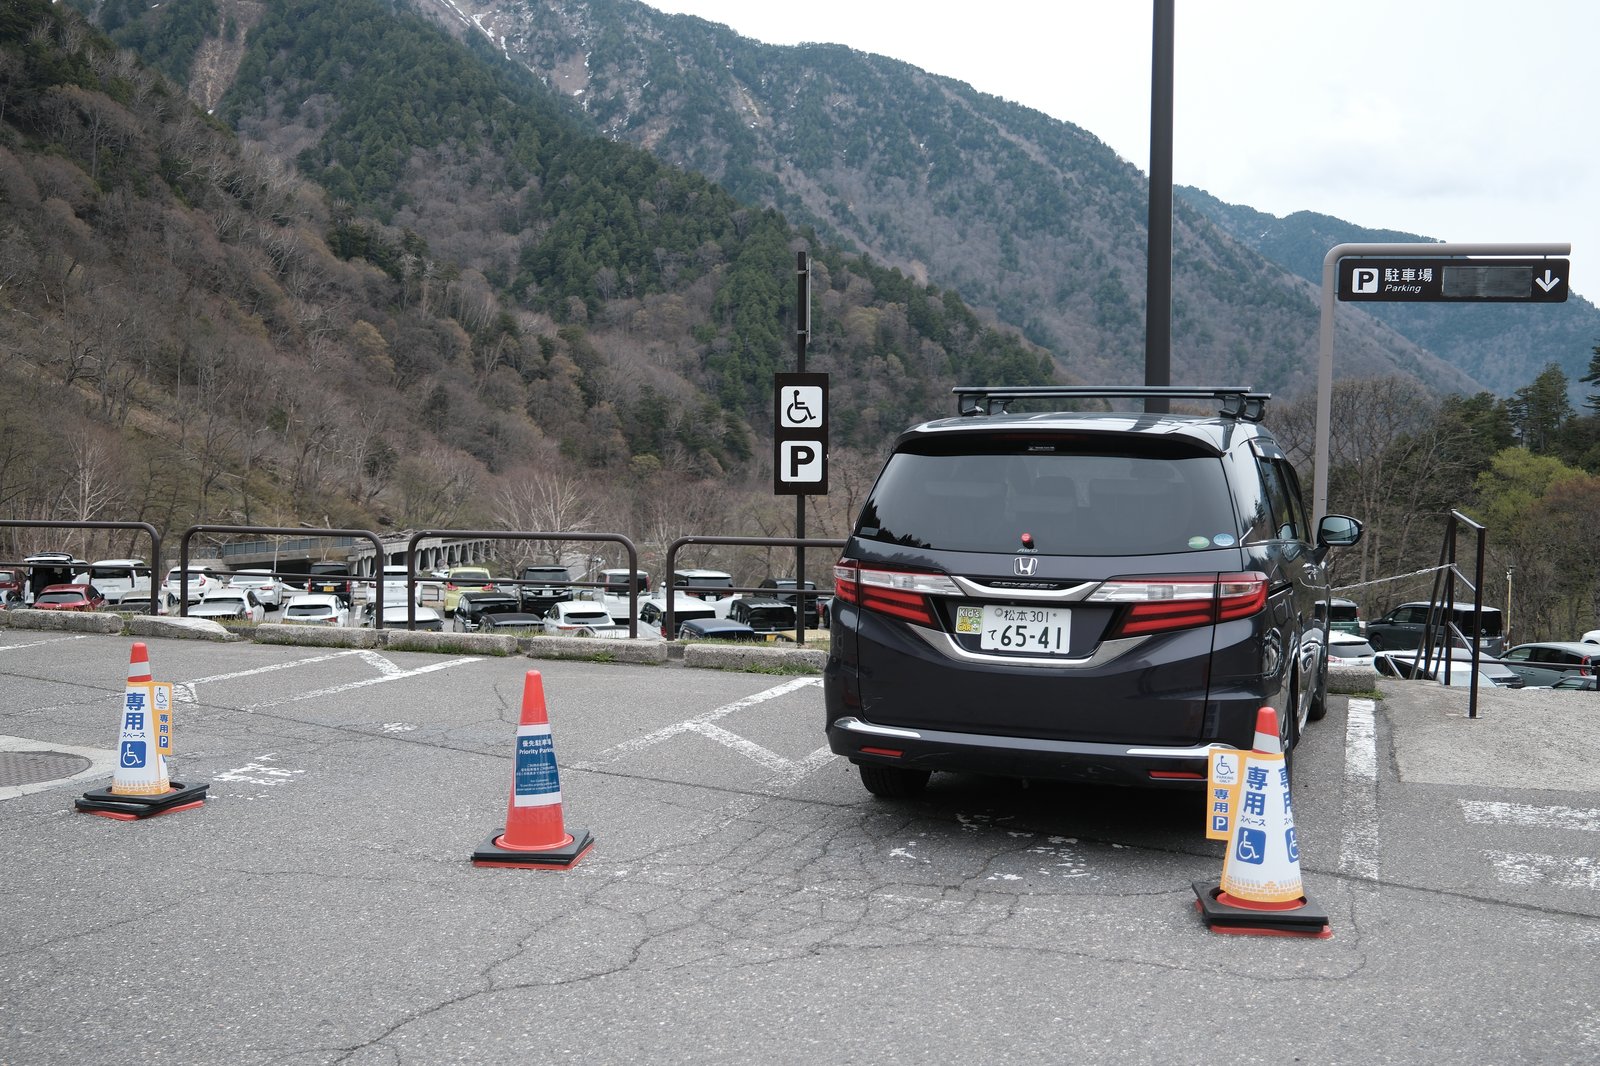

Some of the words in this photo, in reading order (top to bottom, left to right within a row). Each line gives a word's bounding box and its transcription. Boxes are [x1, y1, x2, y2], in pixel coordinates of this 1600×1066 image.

[1357, 270, 1375, 291] P
[1384, 267, 1432, 282] 駐車場
[1385, 284, 1421, 294] Parking
[790, 446, 815, 477] P
[1003, 609, 1028, 622] 松本
[1029, 610, 1049, 623] 301
[988, 629, 997, 640] て
[1000, 624, 1061, 649] 65-41
[125, 692, 146, 730] 専用
[122, 731, 146, 739] スペース
[1243, 766, 1269, 816] 専用
[1216, 817, 1226, 830] P
